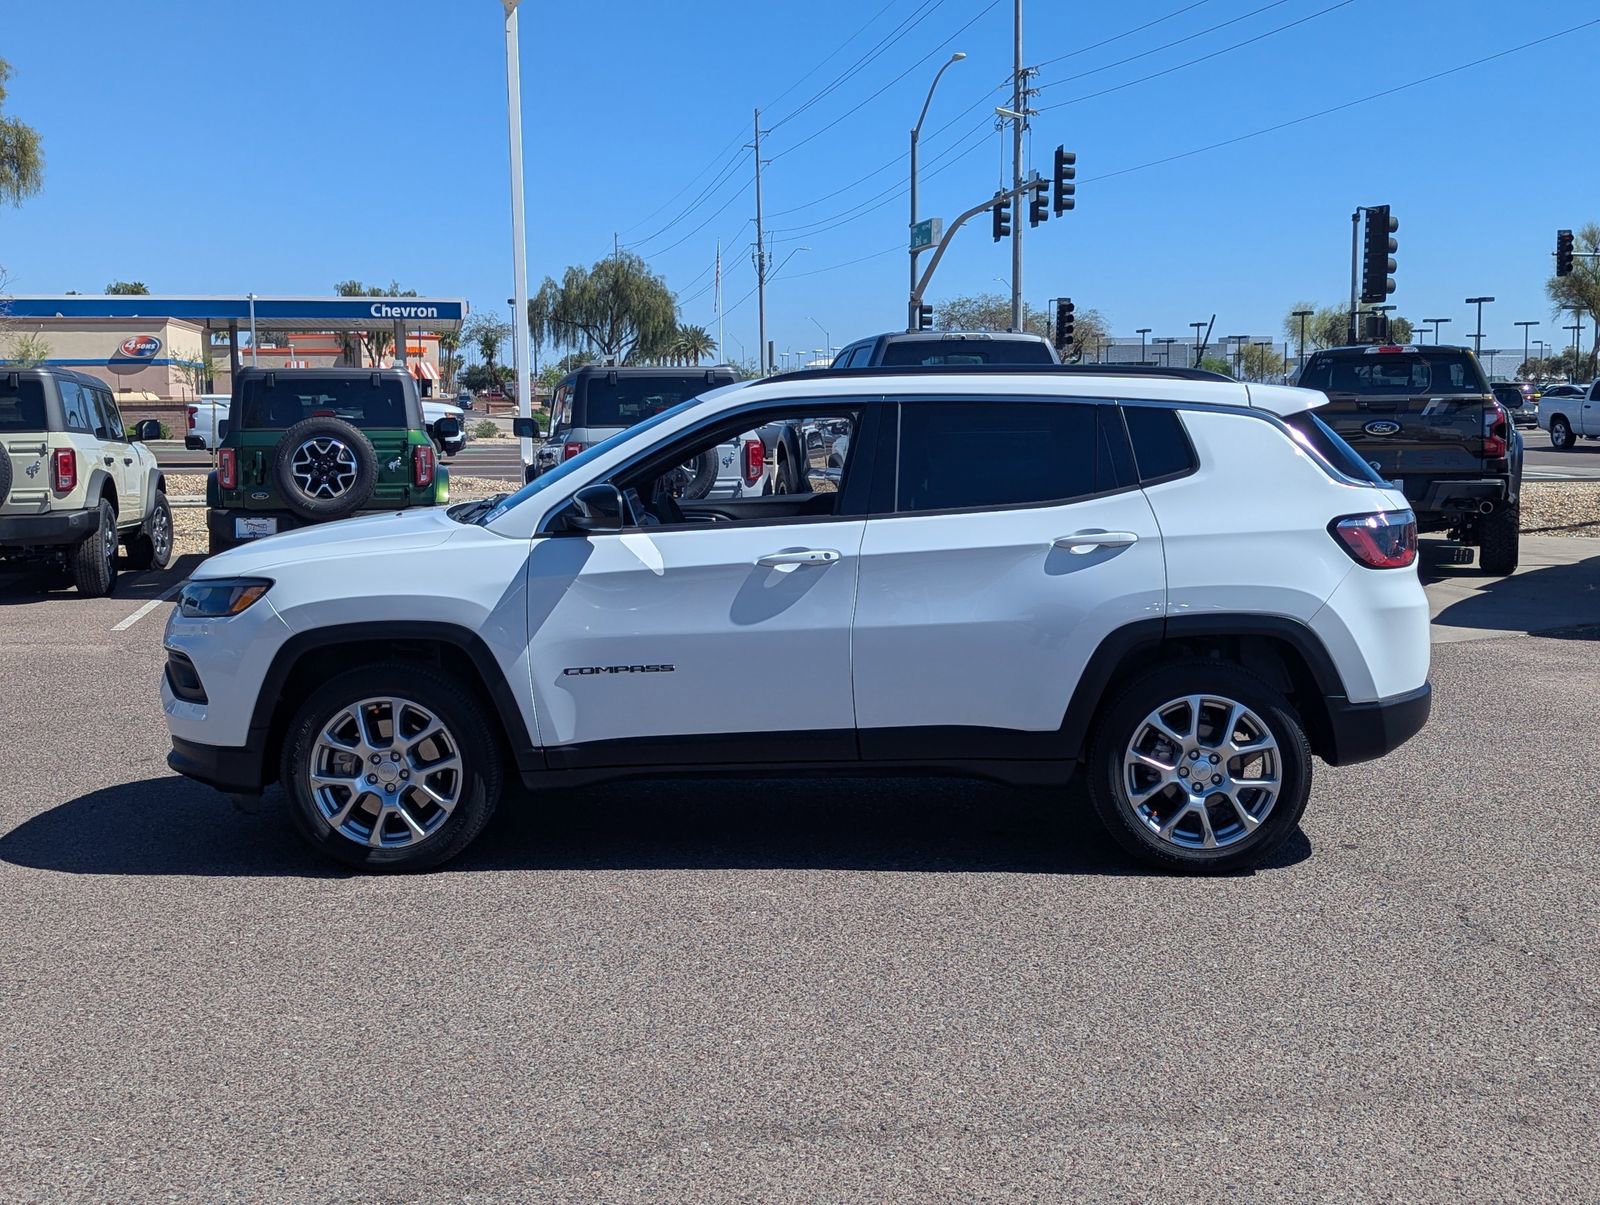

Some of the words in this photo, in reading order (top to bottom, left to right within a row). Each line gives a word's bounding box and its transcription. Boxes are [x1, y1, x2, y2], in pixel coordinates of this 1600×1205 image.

[370, 303, 438, 318] Chevron
[1372, 423, 1392, 432] Ford
[563, 664, 676, 676] COMPASS
